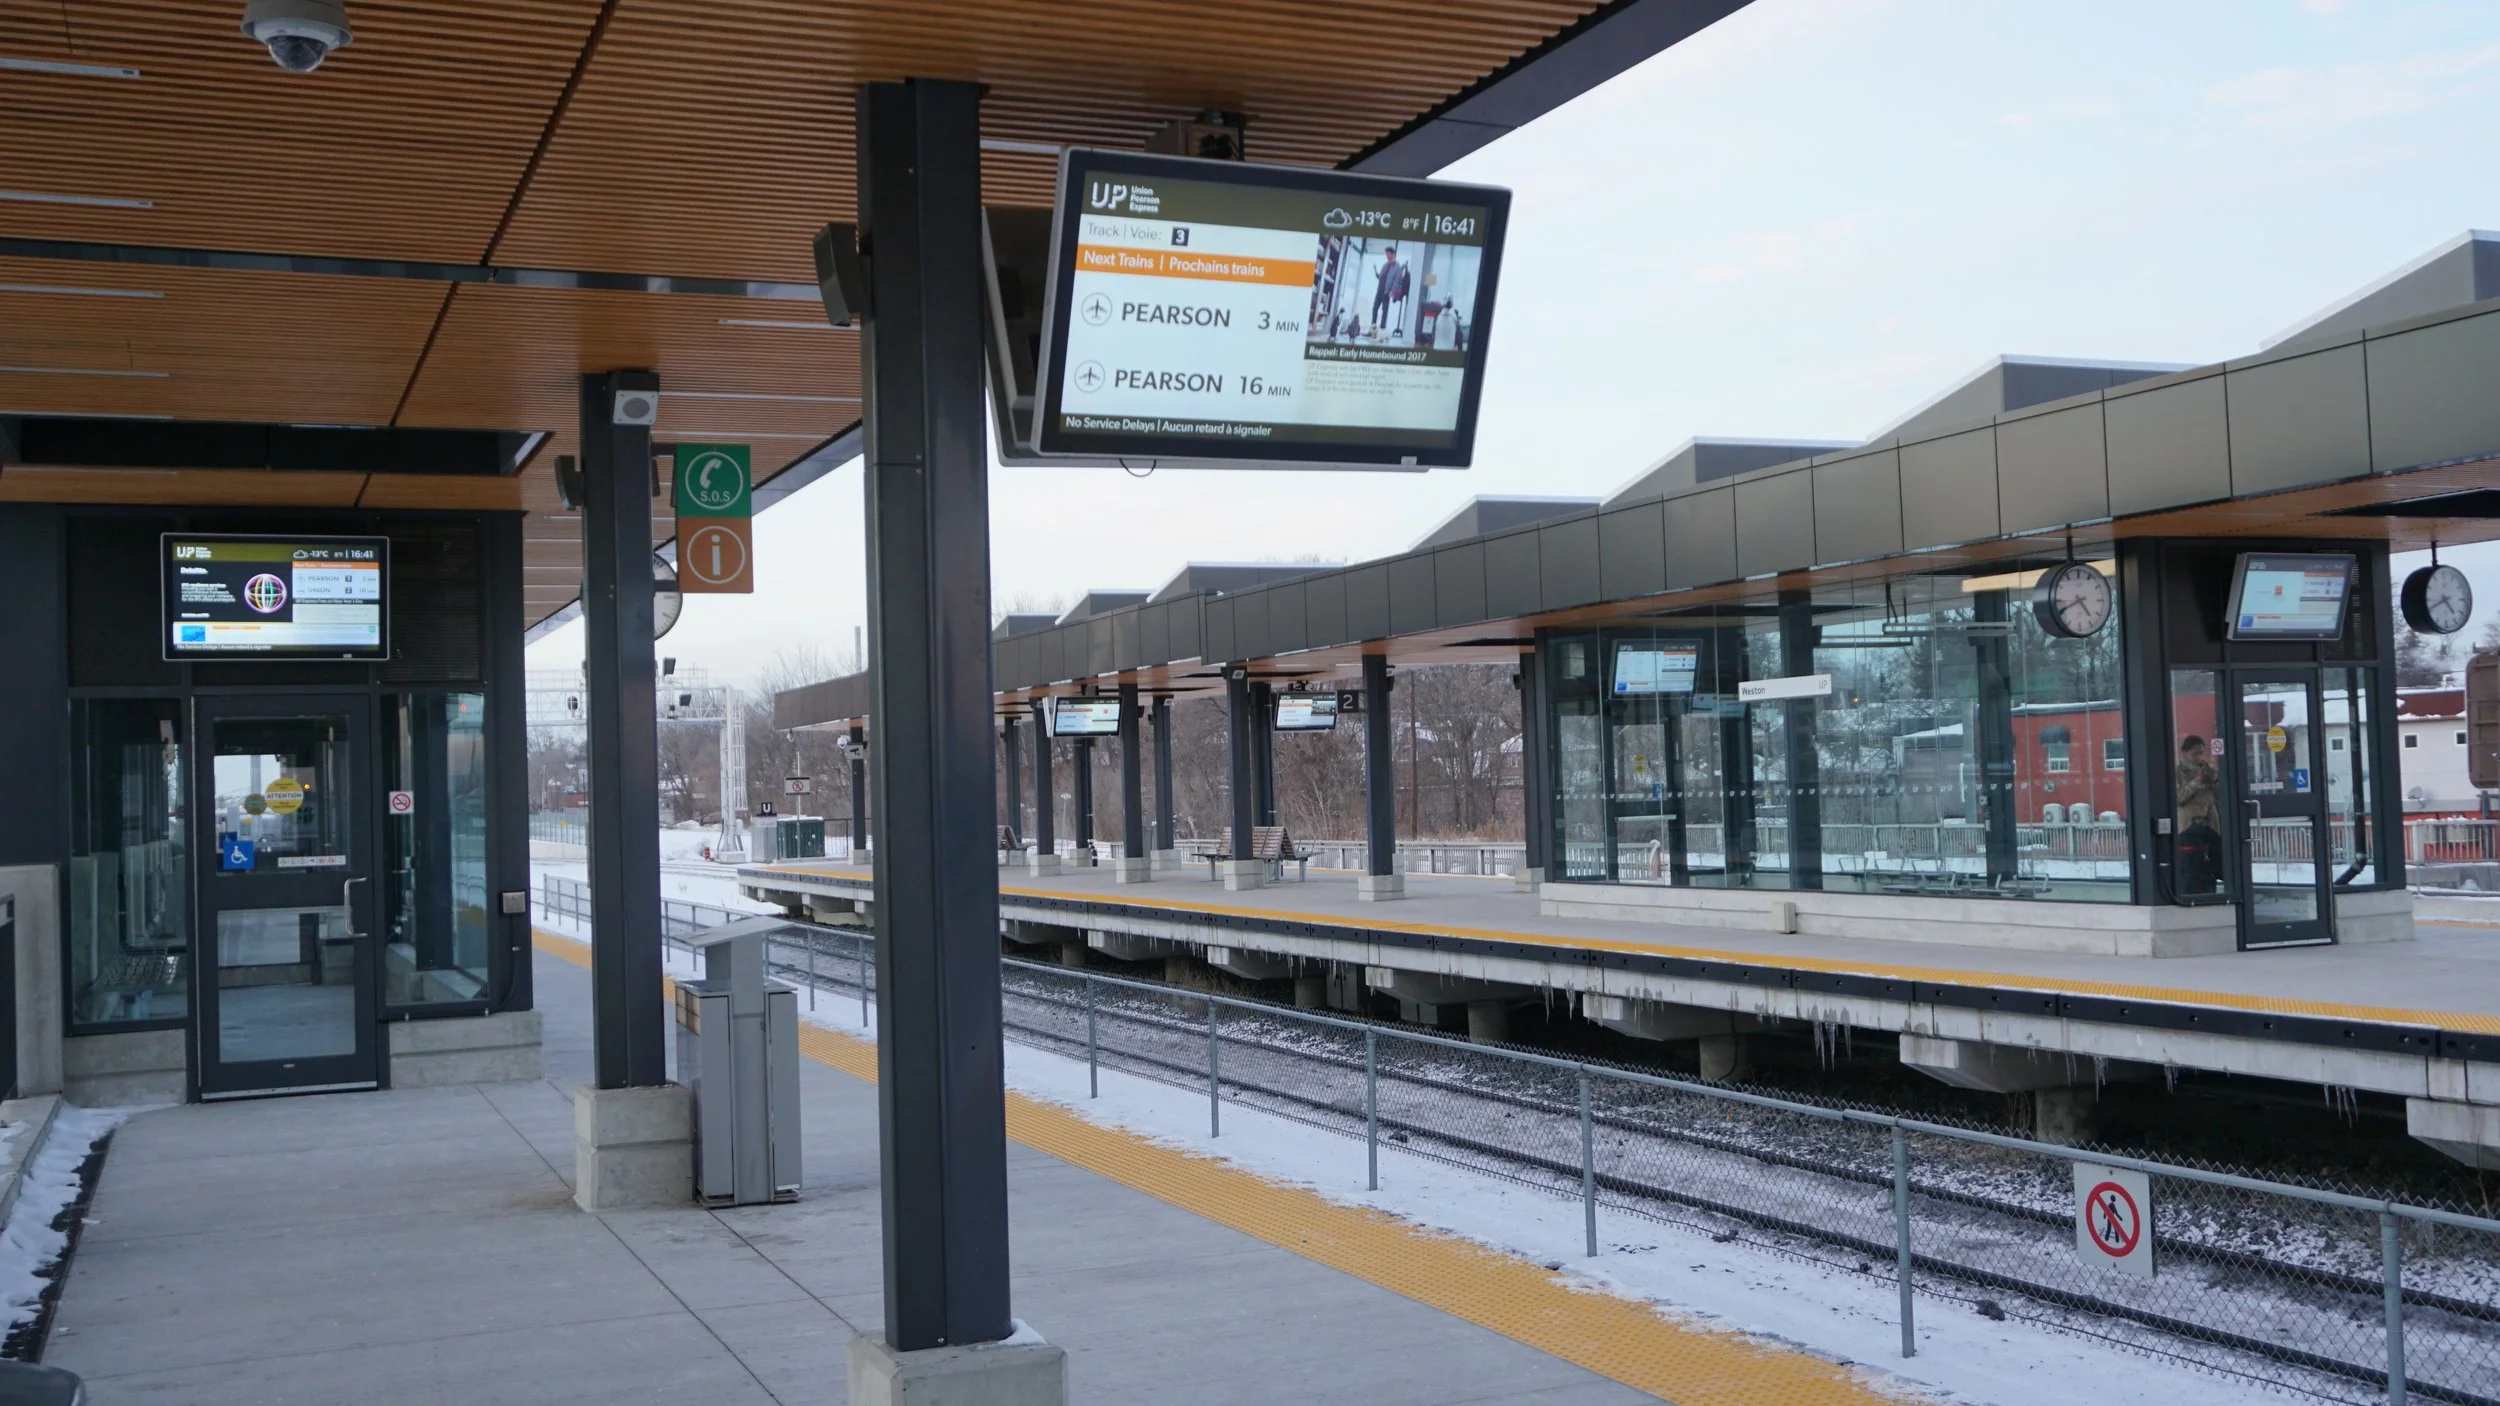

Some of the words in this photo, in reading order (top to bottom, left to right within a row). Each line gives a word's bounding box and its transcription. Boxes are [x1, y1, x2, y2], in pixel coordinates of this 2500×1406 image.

[1091, 182, 1128, 210] UP
[1131, 185, 1154, 196] Union
[1129, 202, 1159, 212] Express
[1130, 194, 1160, 205] Pearson
[1087, 222, 1119, 238] Track
[1175, 229, 1185, 244] 3
[1434, 215, 1475, 236] 16:41
[1083, 250, 1115, 266] Next
[1119, 252, 1154, 269] Trains
[1169, 256, 1229, 274] Prochains
[1232, 263, 1265, 277] trains
[1121, 302, 1231, 328] PEARSON
[1257, 311, 1270, 330] 3
[1275, 321, 1300, 332] MIN
[1340, 347, 1358, 360] Early
[1359, 349, 1406, 361] Homebound
[1407, 352, 1427, 362] 2017
[1114, 369, 1223, 393] PEARSON
[1240, 376, 1263, 395] 16
[1267, 386, 1292, 397] MIN
[1066, 416, 1082, 428] No
[1084, 417, 1120, 430] Service
[1122, 418, 1155, 433] Delays
[1162, 420, 1193, 432] Aucun
[1195, 422, 1225, 434] retard
[1226, 424, 1232, 434] à
[1233, 424, 1272, 438] signaler
[176, 546, 196, 558] UP
[351, 550, 374, 558] 16:41
[1742, 687, 1766, 696] Weston
[1343, 694, 1354, 709] 2
[762, 802, 771, 813] U
